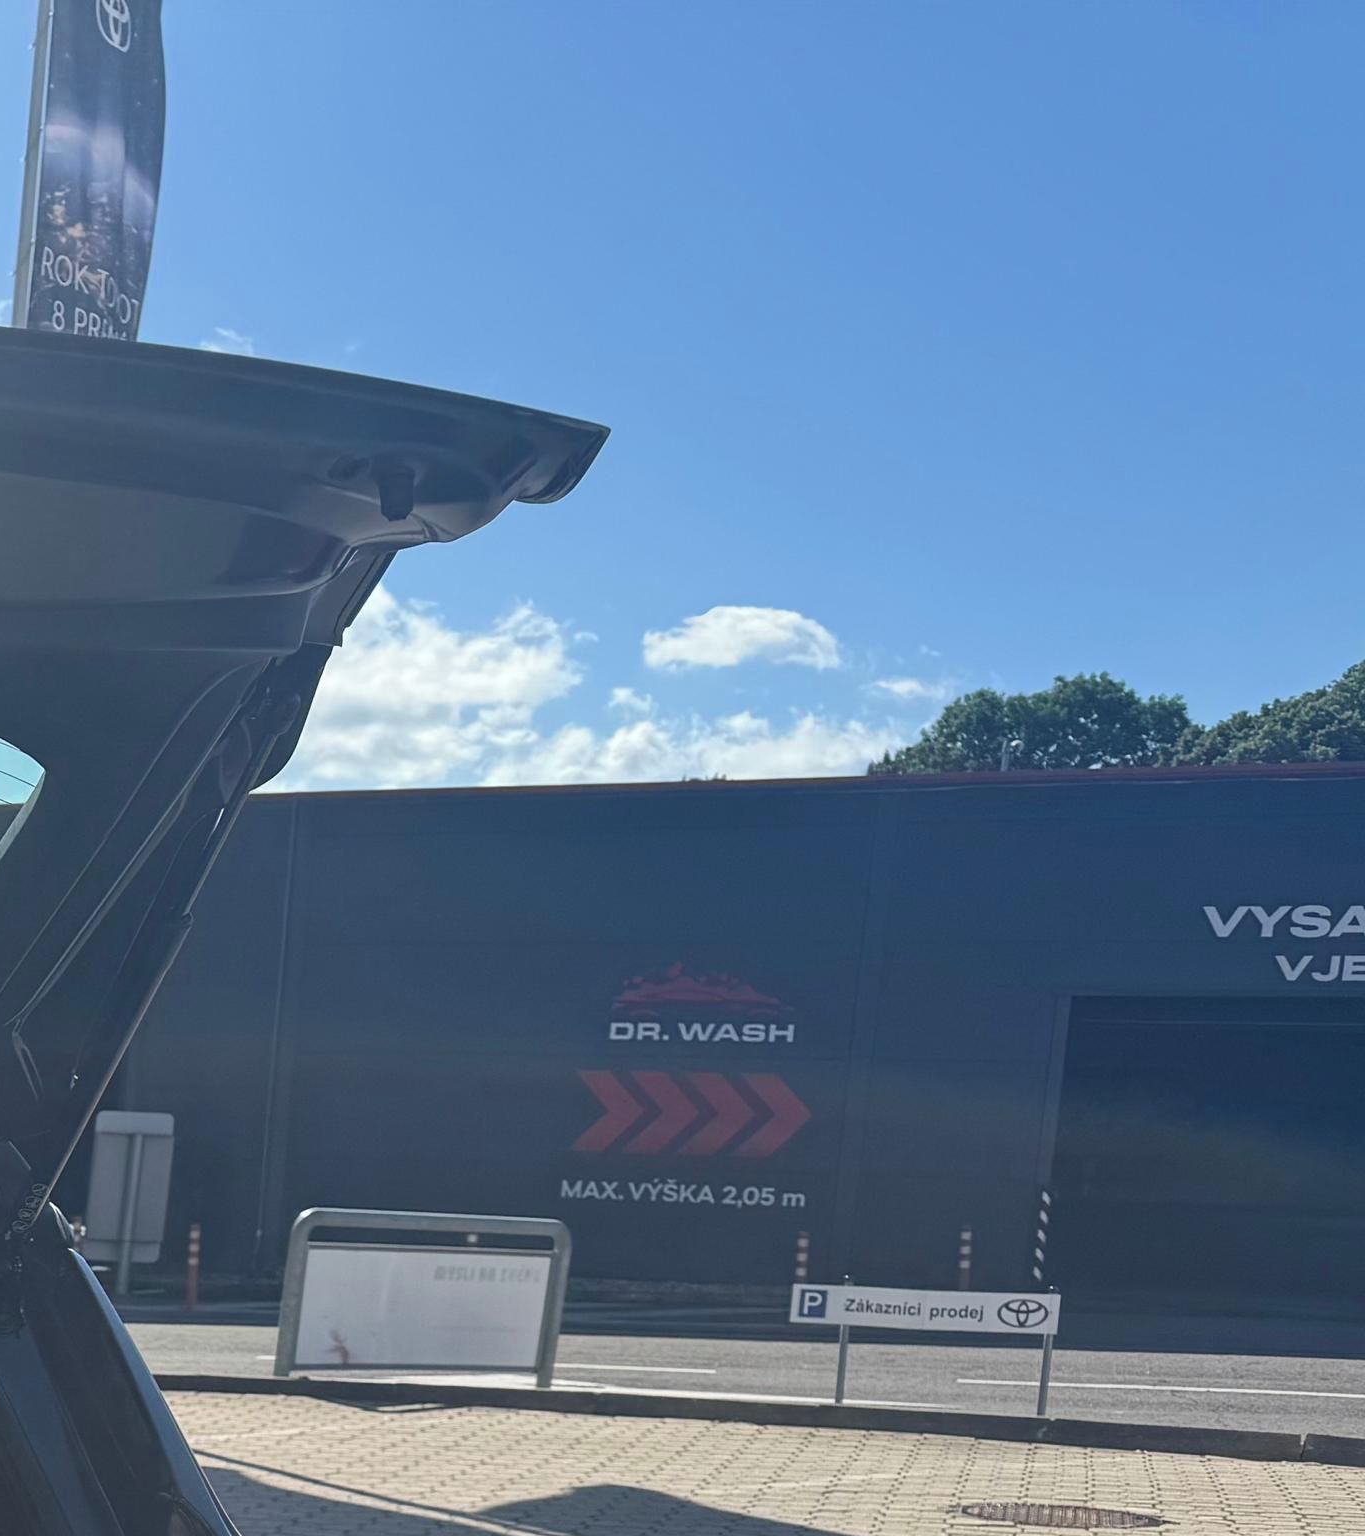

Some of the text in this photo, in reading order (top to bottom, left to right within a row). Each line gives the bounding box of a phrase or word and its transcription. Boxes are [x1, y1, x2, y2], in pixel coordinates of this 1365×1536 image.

[40, 246, 89, 294] ROK
[52, 300, 65, 331] 8
[1202, 905, 1365, 938] VYSA
[1275, 955, 1365, 982] VJE
[608, 1021, 795, 1043] DR. WASH
[560, 1177, 806, 1208] MAX. VÝŠKA 2,05 m
[802, 1292, 984, 1322] P Zákazníci prodej
